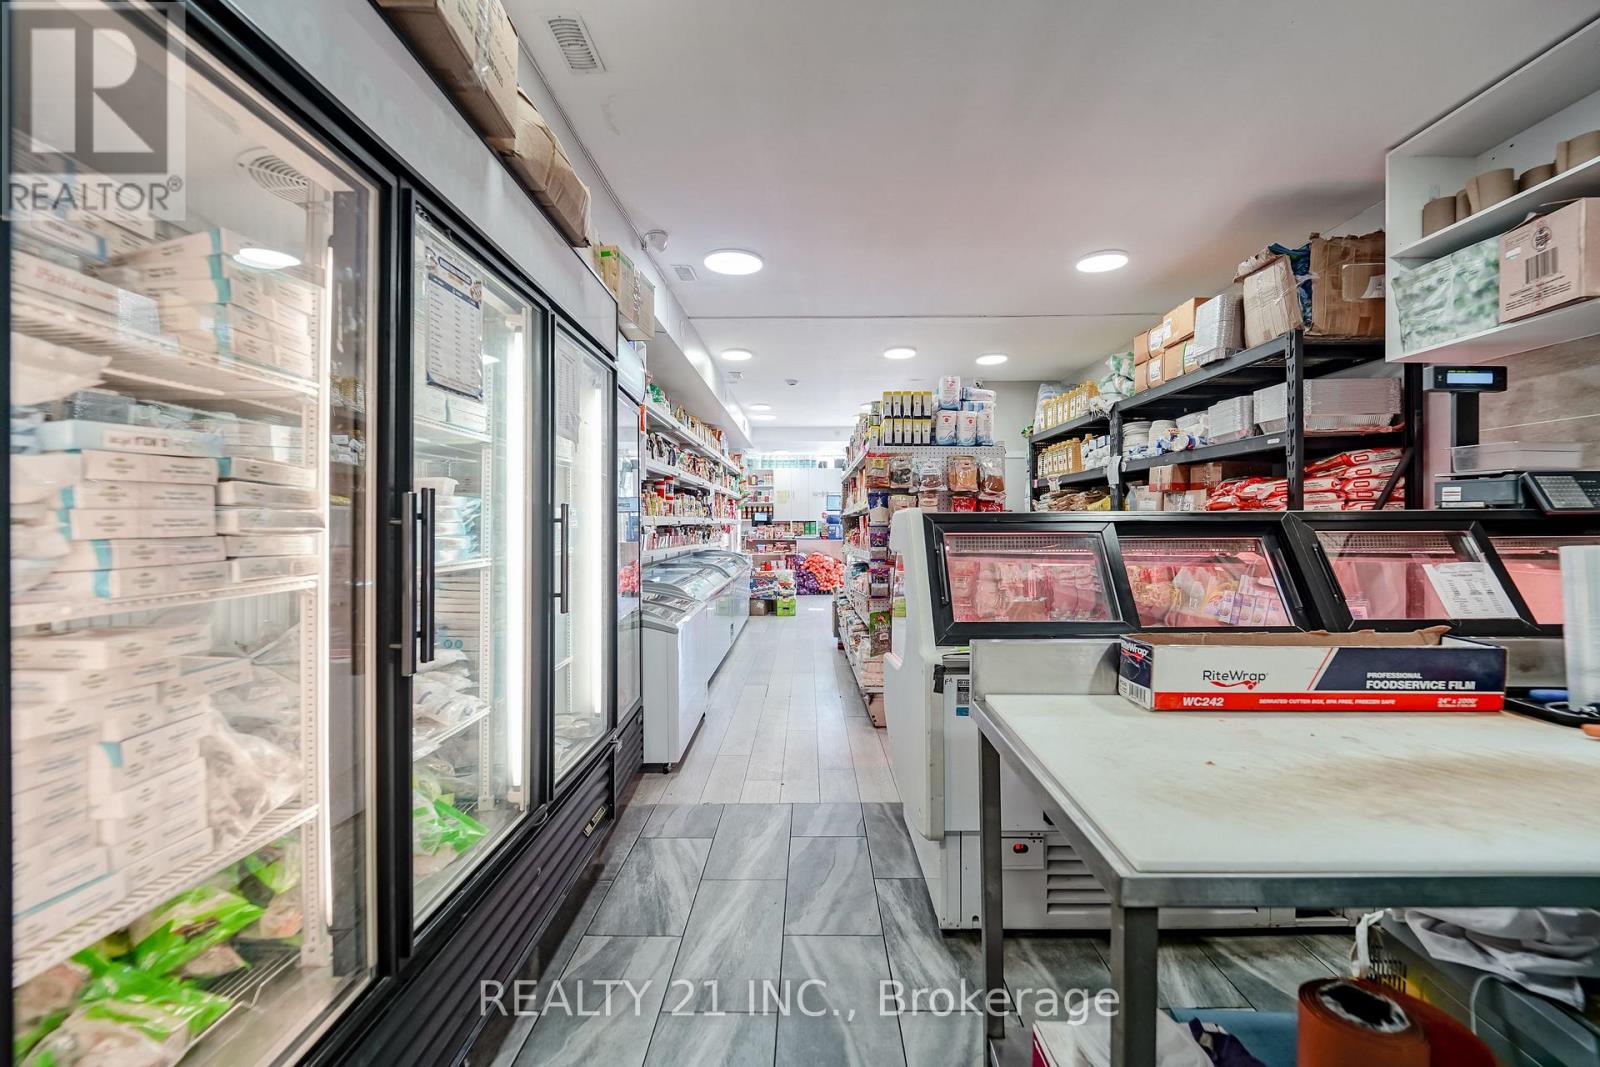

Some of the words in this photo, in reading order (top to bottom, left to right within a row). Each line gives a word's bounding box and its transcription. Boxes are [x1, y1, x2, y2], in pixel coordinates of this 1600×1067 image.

[1366, 680, 1446, 690] FOODSERVICE
[1448, 680, 1476, 690] FILM
[1182, 696, 1225, 707] WC242
